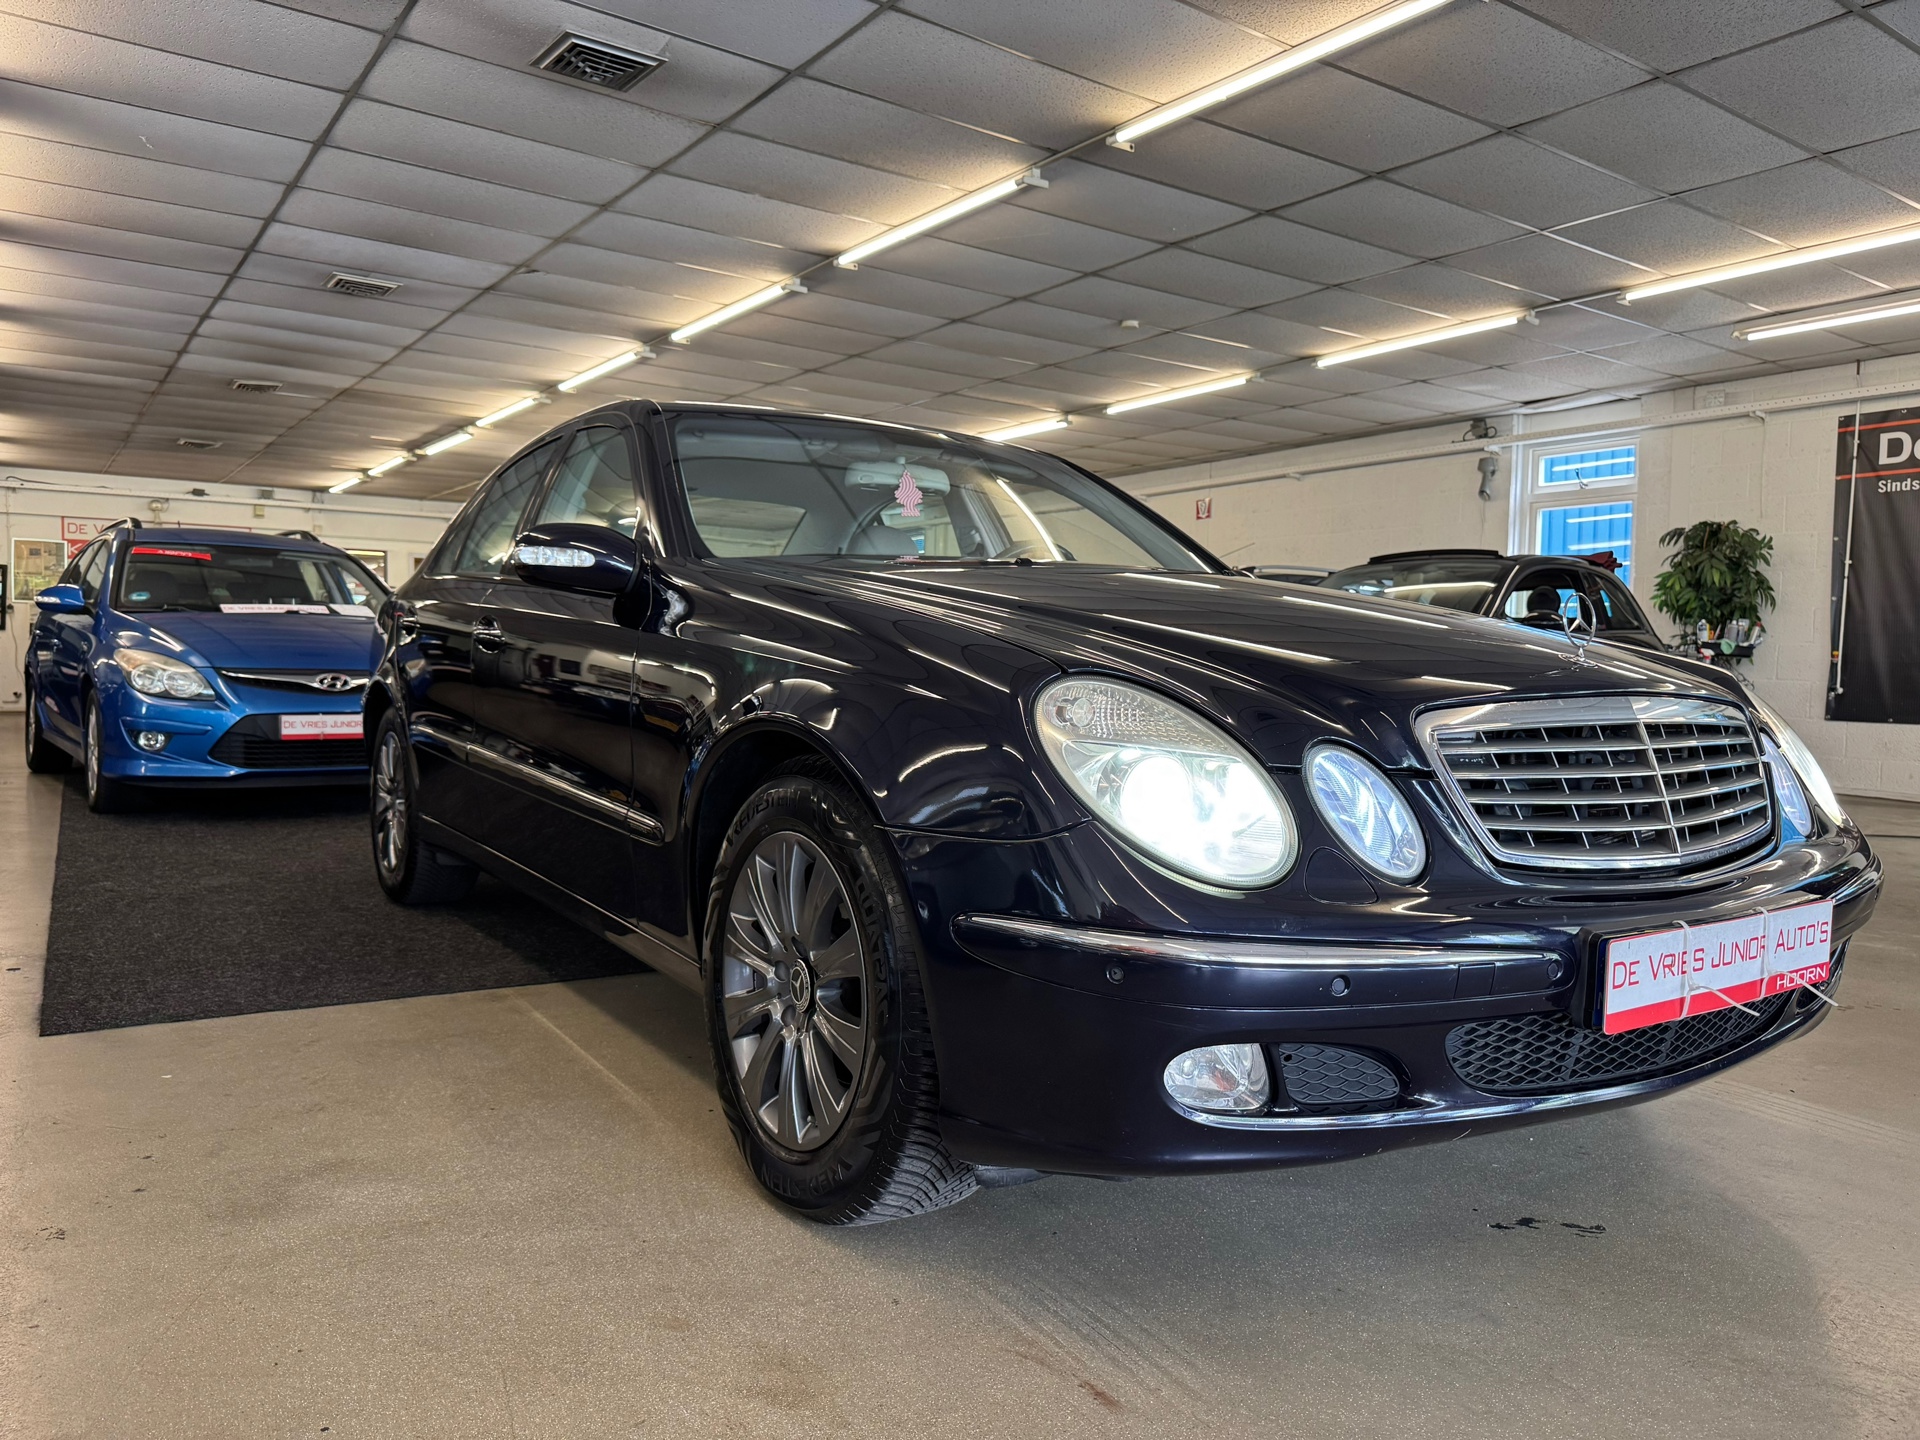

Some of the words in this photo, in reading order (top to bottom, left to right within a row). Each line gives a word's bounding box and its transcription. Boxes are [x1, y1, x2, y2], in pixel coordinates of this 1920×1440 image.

[1879, 431, 1920, 465] D
[1877, 478, 1920, 493] Sinds
[67, 522, 88, 535] DE
[283, 720, 297, 729] DE
[300, 720, 328, 729] VRIES
[330, 720, 362, 729] JUNIOR
[1611, 960, 1640, 990] DE
[1649, 947, 1705, 981] VRIES
[1774, 920, 1829, 954] AUTO'S
[1776, 965, 1827, 991] HOORN
